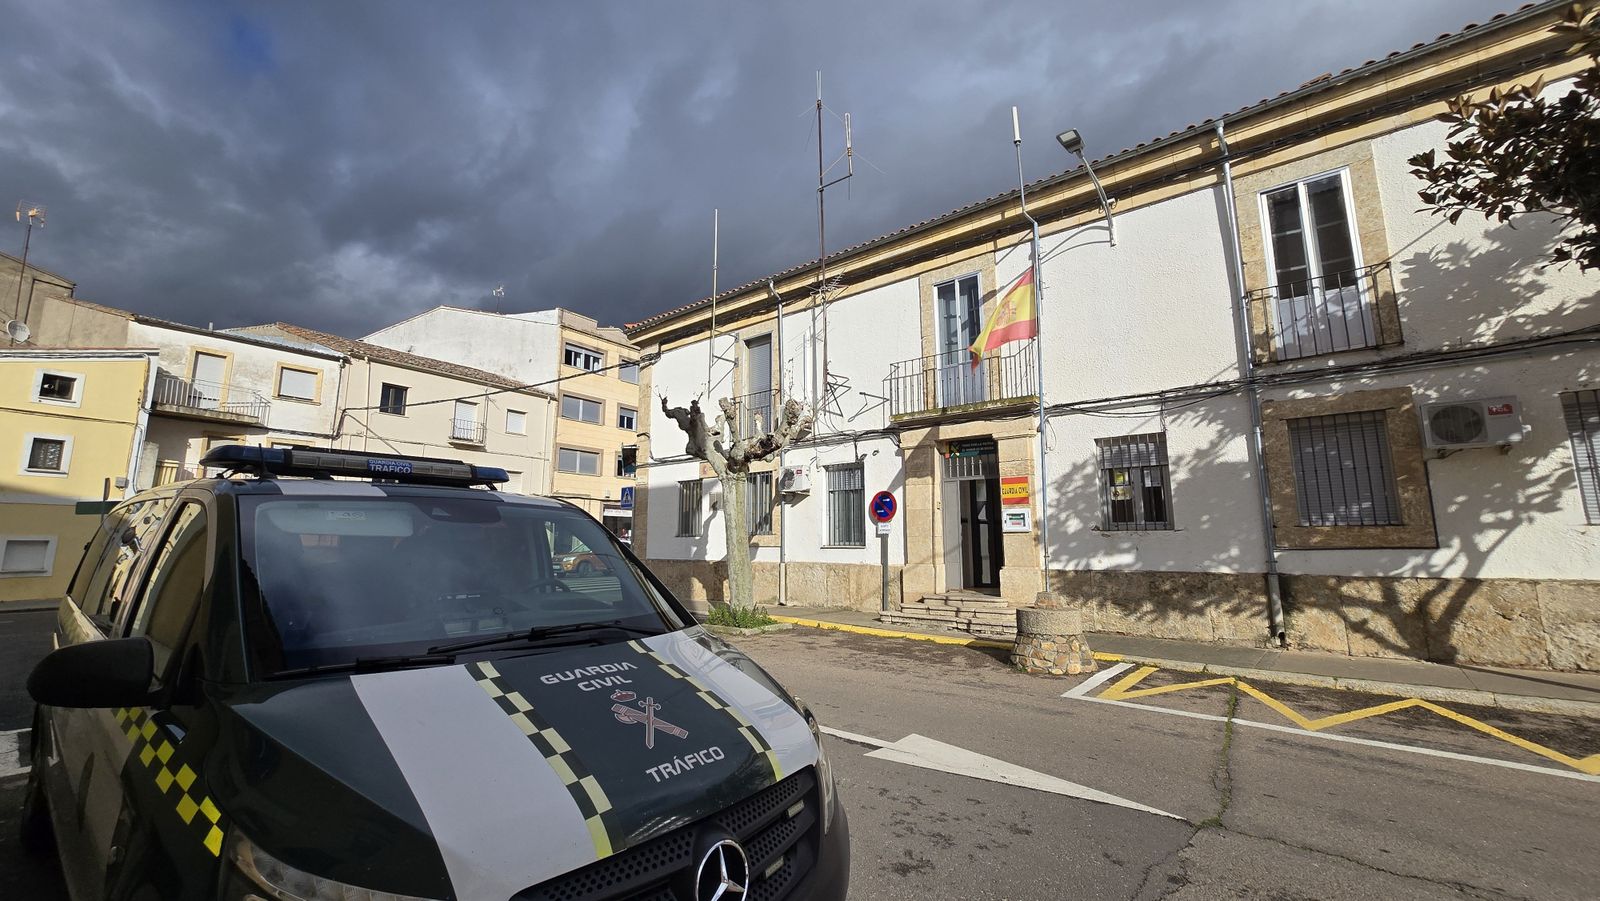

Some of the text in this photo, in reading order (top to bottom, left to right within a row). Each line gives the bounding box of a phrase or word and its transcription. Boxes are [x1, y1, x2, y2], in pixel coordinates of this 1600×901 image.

[540, 661, 639, 685] GUARDIA
[577, 675, 633, 692] CIVIL
[645, 746, 725, 783] TRÁFICO
